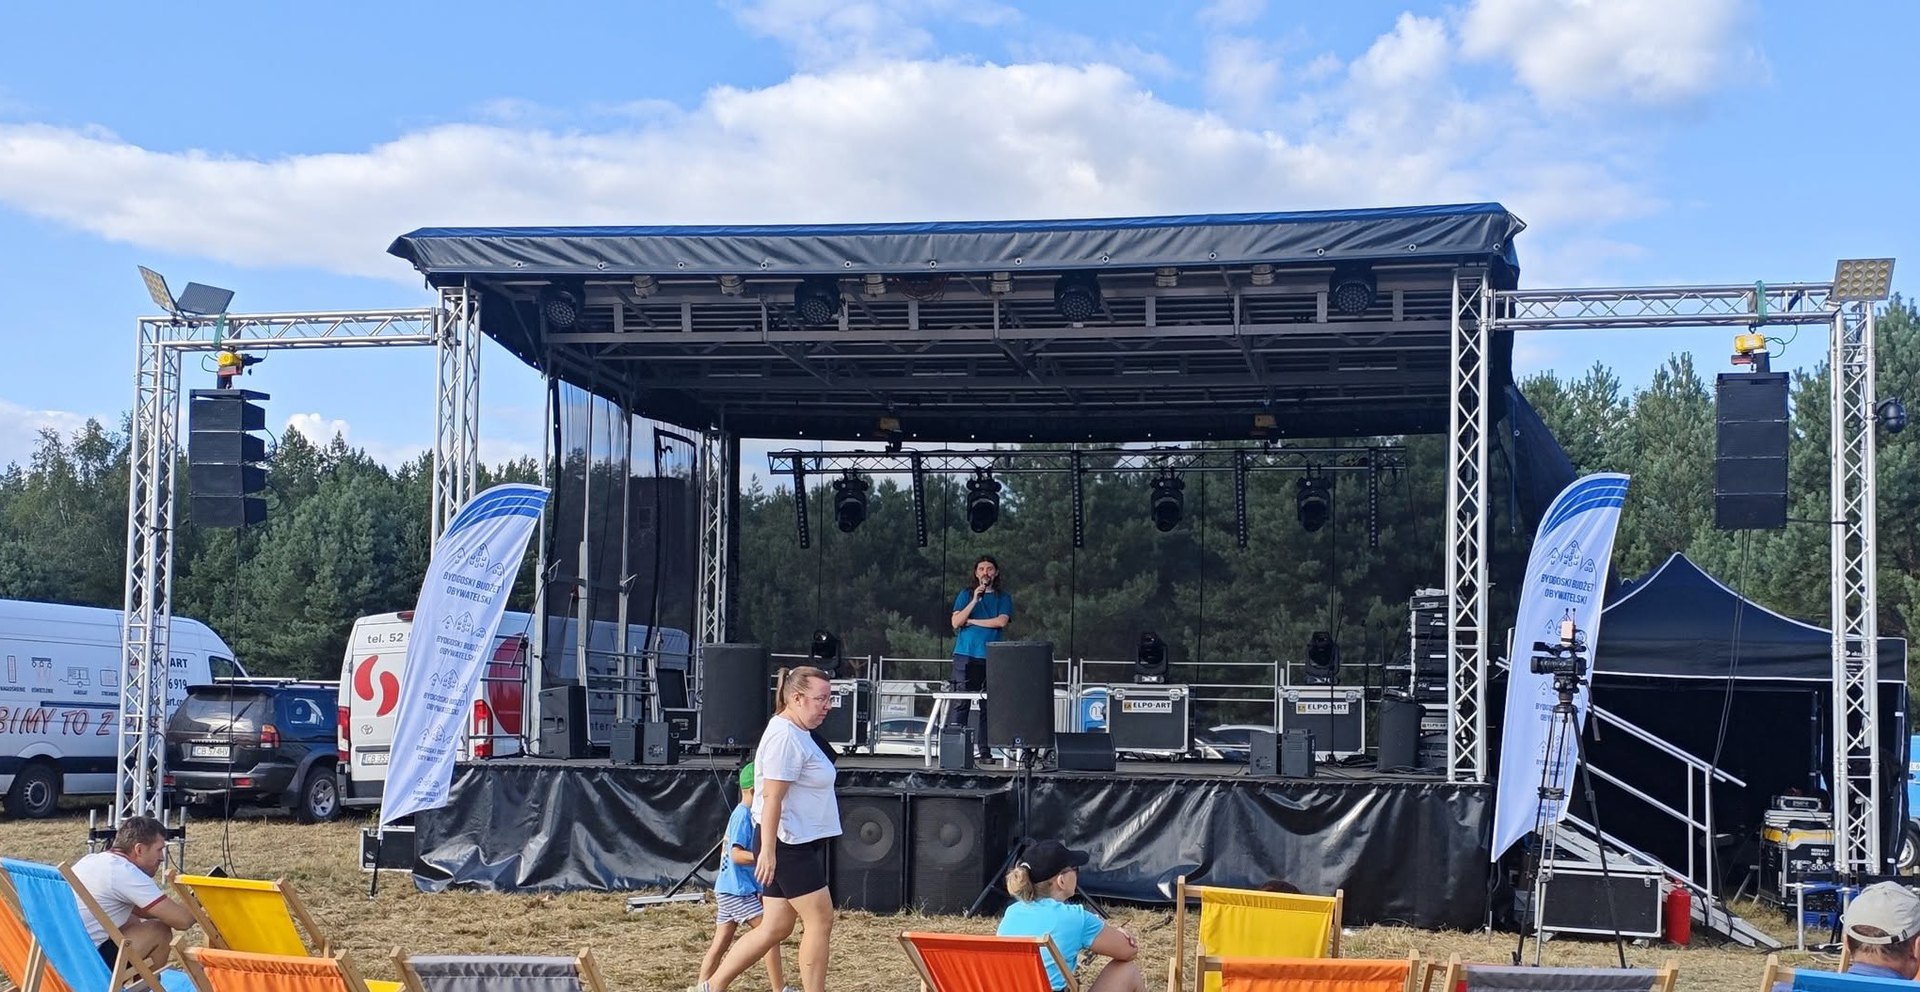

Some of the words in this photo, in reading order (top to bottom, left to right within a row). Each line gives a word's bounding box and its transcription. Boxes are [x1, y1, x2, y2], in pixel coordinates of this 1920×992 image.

[443, 571, 476, 587] BYDGOSKI
[1540, 573, 1572, 587] BYDGOSKI
[446, 586, 492, 605] OBYWATELSKI
[1544, 588, 1588, 605] OBYWATELSKI
[367, 633, 384, 643] tel.
[62, 709, 89, 736] TO
